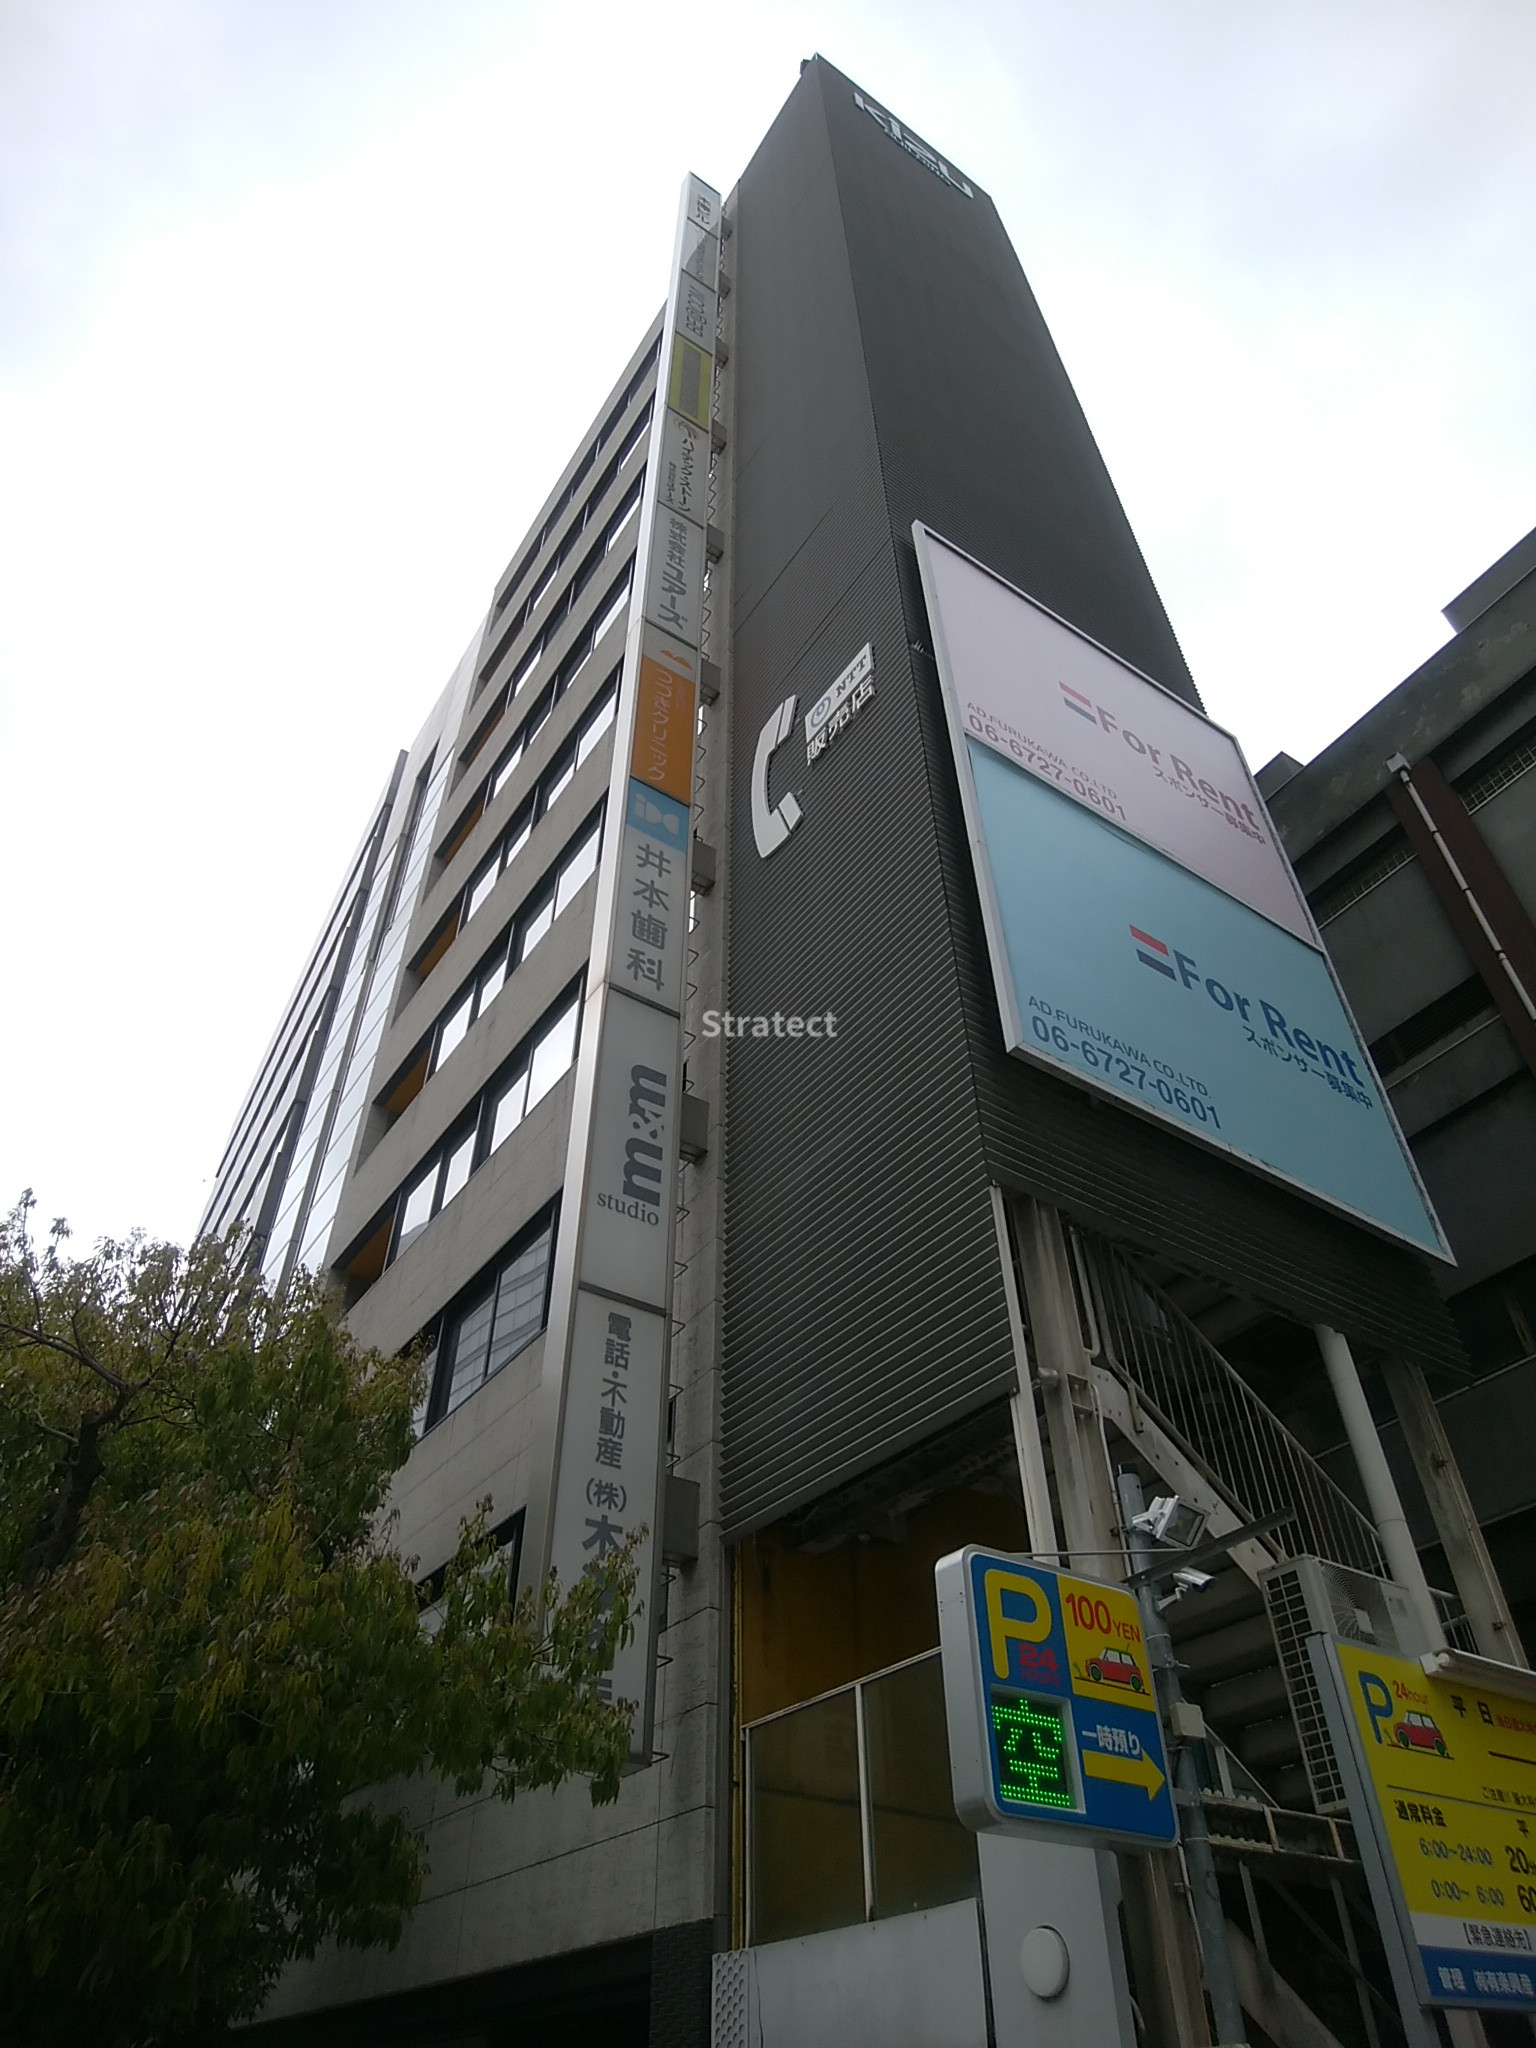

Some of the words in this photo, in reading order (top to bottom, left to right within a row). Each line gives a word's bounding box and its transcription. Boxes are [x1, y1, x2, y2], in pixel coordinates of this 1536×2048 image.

[836, 655, 868, 699] NTT
[806, 674, 876, 767] 販売店
[969, 714, 1127, 821] 06-6727-0601
[1096, 704, 1161, 766] For
[1170, 753, 1261, 831] Rent
[1173, 949, 1251, 1023] For
[1259, 999, 1366, 1088] Rent
[1032, 1015, 1221, 1129] 06-6727-0601
[597, 1192, 659, 1227] studio
[984, 1569, 1052, 1680] P
[1018, 1643, 1059, 1673] 24
[1065, 1592, 1113, 1635] 100
[1112, 1619, 1142, 1643] YEN
[1081, 1724, 1141, 1756] 一時預り
[1358, 1670, 1394, 1745] P
[991, 1698, 1071, 1807] 空
[1394, 1799, 1447, 1827] 通常料金
